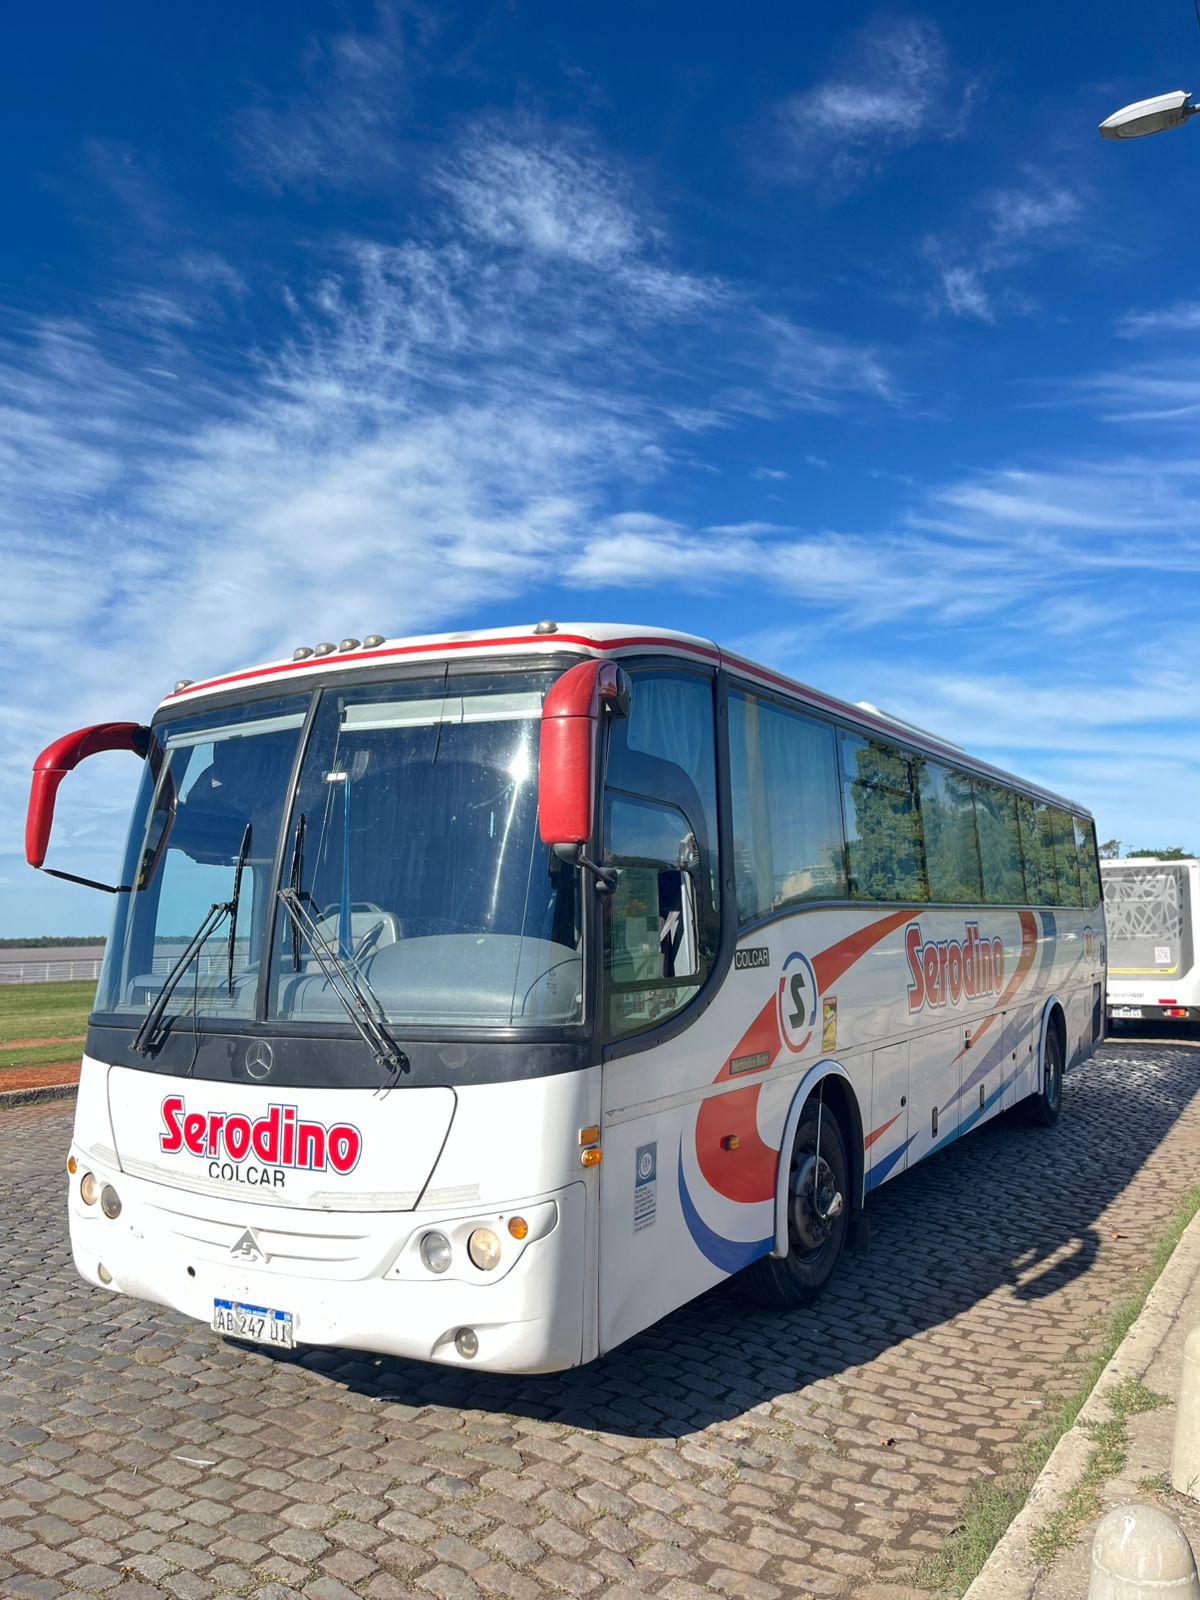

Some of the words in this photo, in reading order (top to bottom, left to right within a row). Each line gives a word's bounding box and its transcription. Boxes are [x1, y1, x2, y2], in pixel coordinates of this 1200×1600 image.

[735, 949, 769, 968] COLCAR
[905, 921, 1004, 1014] Serodino
[788, 973, 806, 1029] S
[159, 1094, 362, 1176] Serodino
[208, 1161, 285, 1188] COLCAR
[217, 1310, 234, 1331] AB
[239, 1315, 265, 1338] 247
